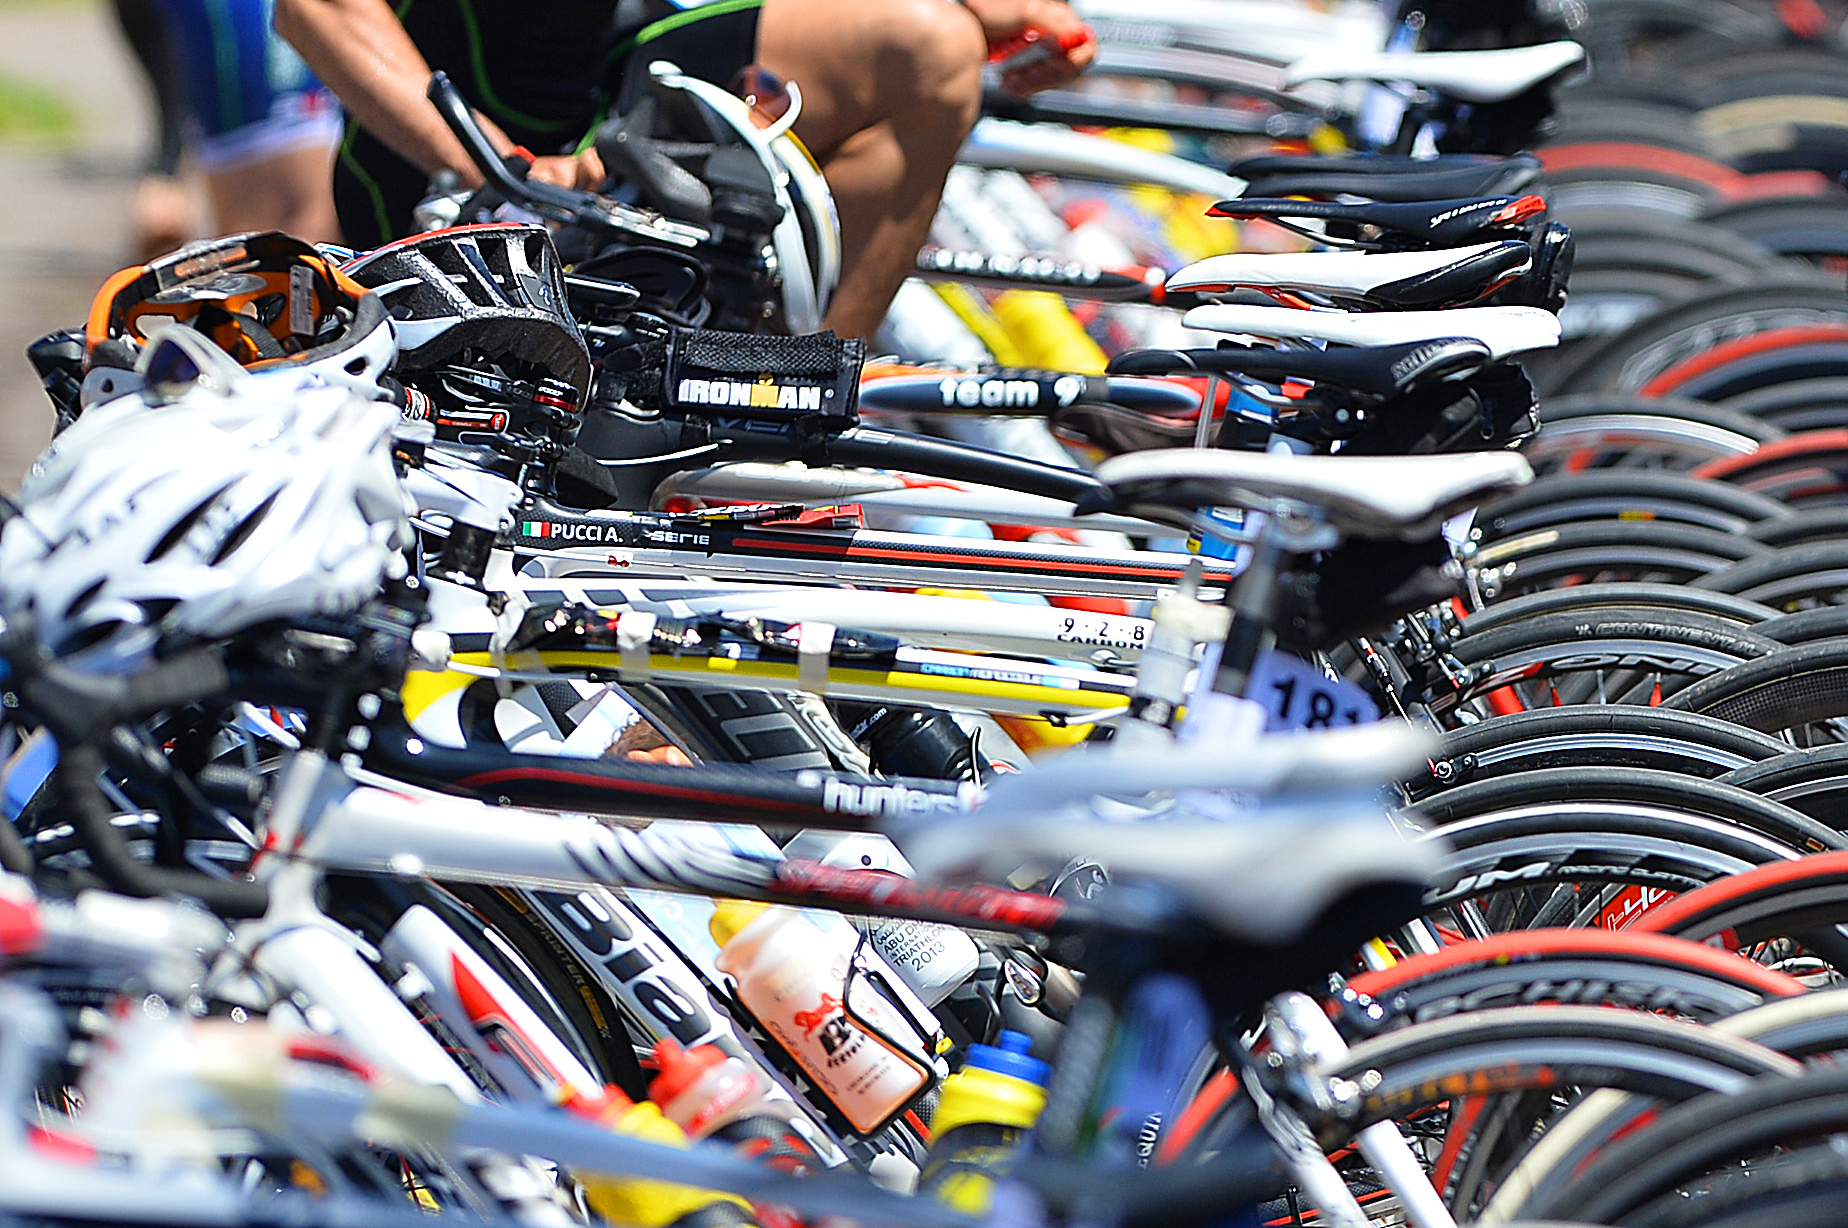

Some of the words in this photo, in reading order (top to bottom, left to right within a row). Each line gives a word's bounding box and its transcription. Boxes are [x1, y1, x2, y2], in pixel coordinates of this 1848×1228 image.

[678, 377, 822, 410] IRONMAN
[938, 377, 1040, 409] team
[550, 522, 603, 541] PUCCI
[604, 526, 624, 543] A.
[525, 912, 586, 986] SPRINTER
[884, 932, 905, 954] ABU
[893, 925, 947, 967] TRIATHLON
[911, 940, 945, 972] 2013
